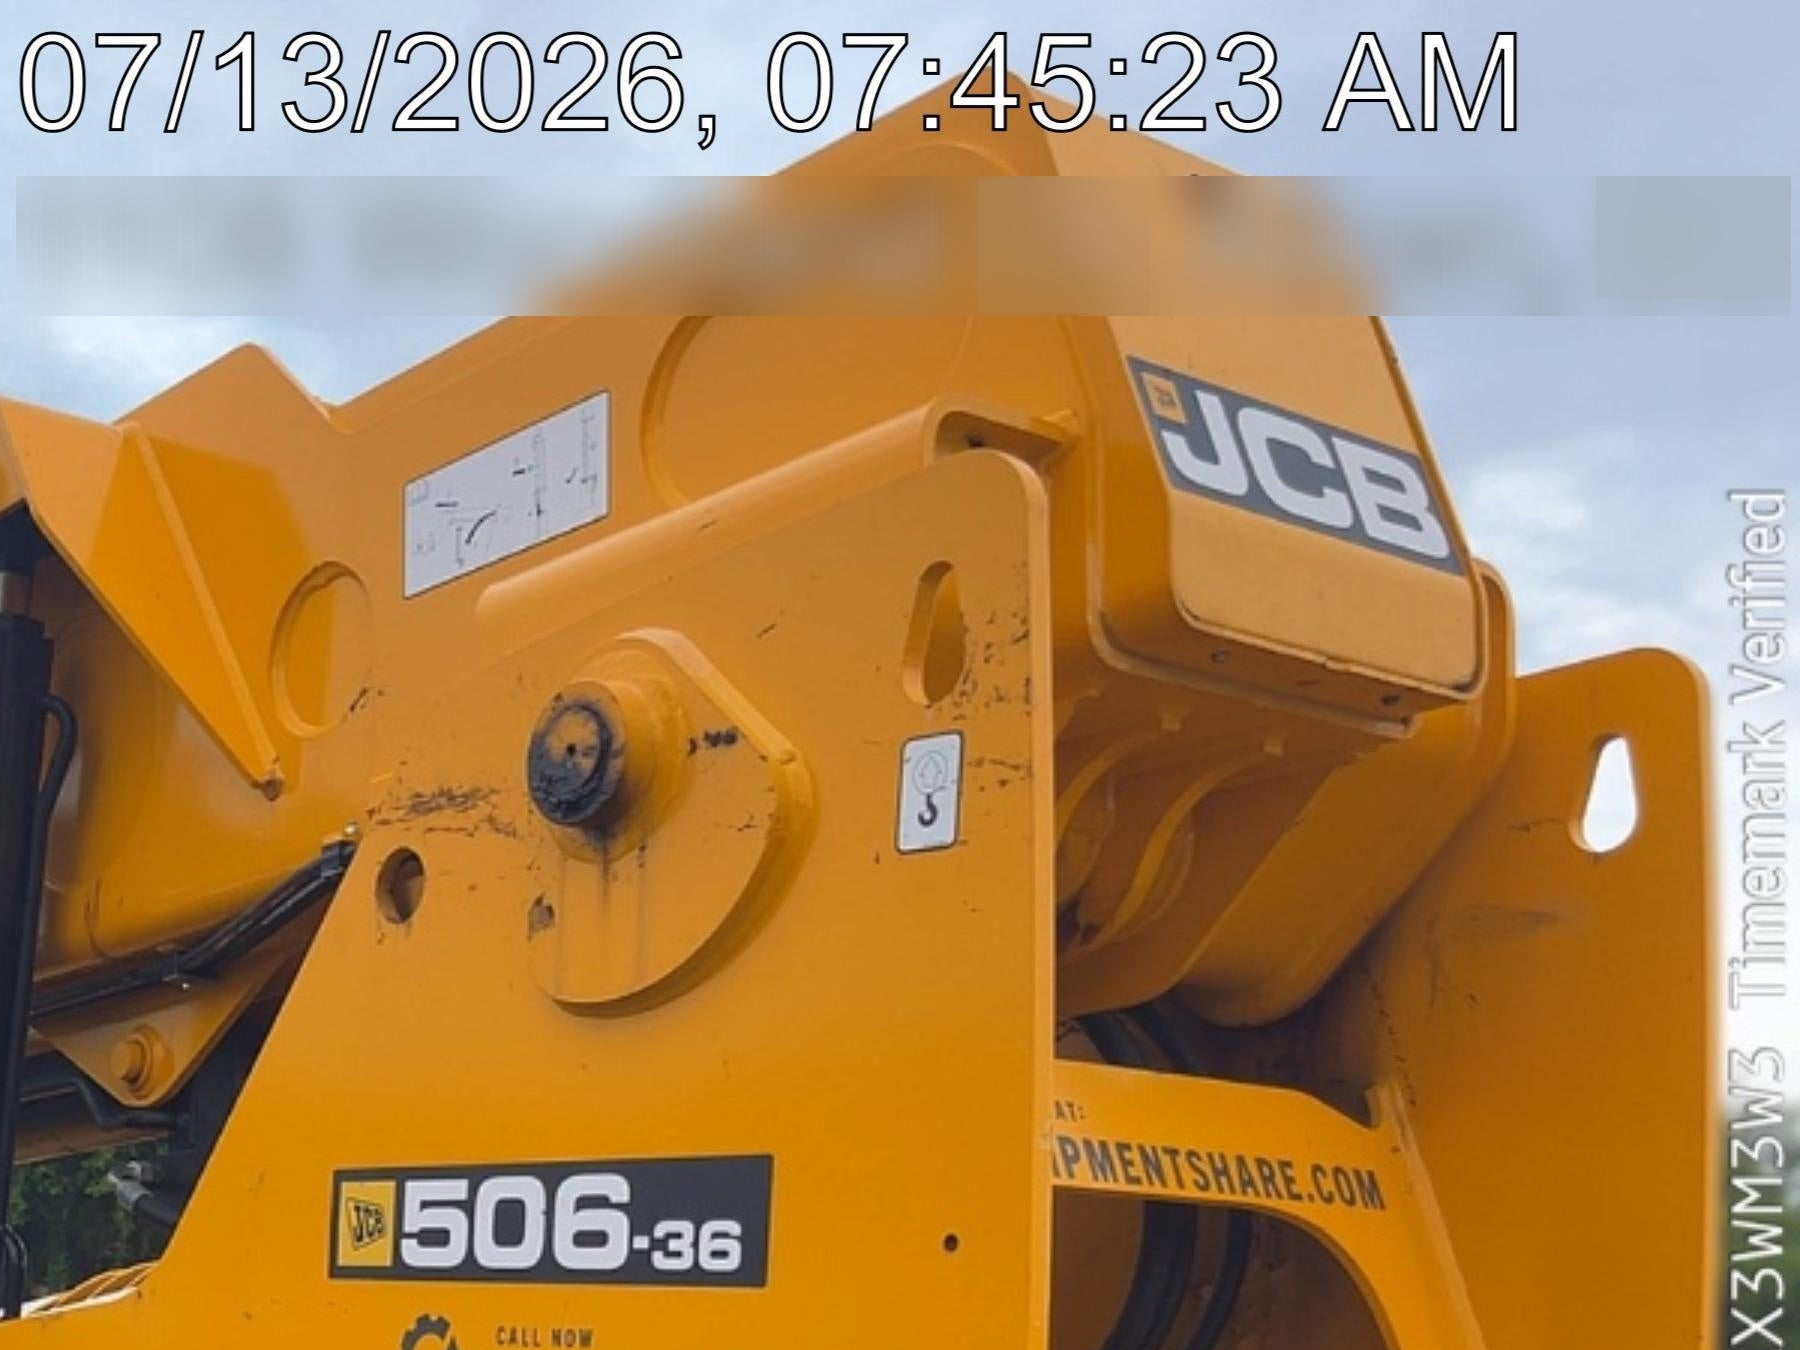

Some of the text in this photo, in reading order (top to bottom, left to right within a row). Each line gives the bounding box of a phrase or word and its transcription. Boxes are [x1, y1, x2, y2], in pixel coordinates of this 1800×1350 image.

[1159, 389, 1450, 559] JCB
[1054, 1100, 1085, 1122] AT:
[400, 1173, 742, 1273] 506-36
[496, 1326, 593, 1348] CALL NOW
